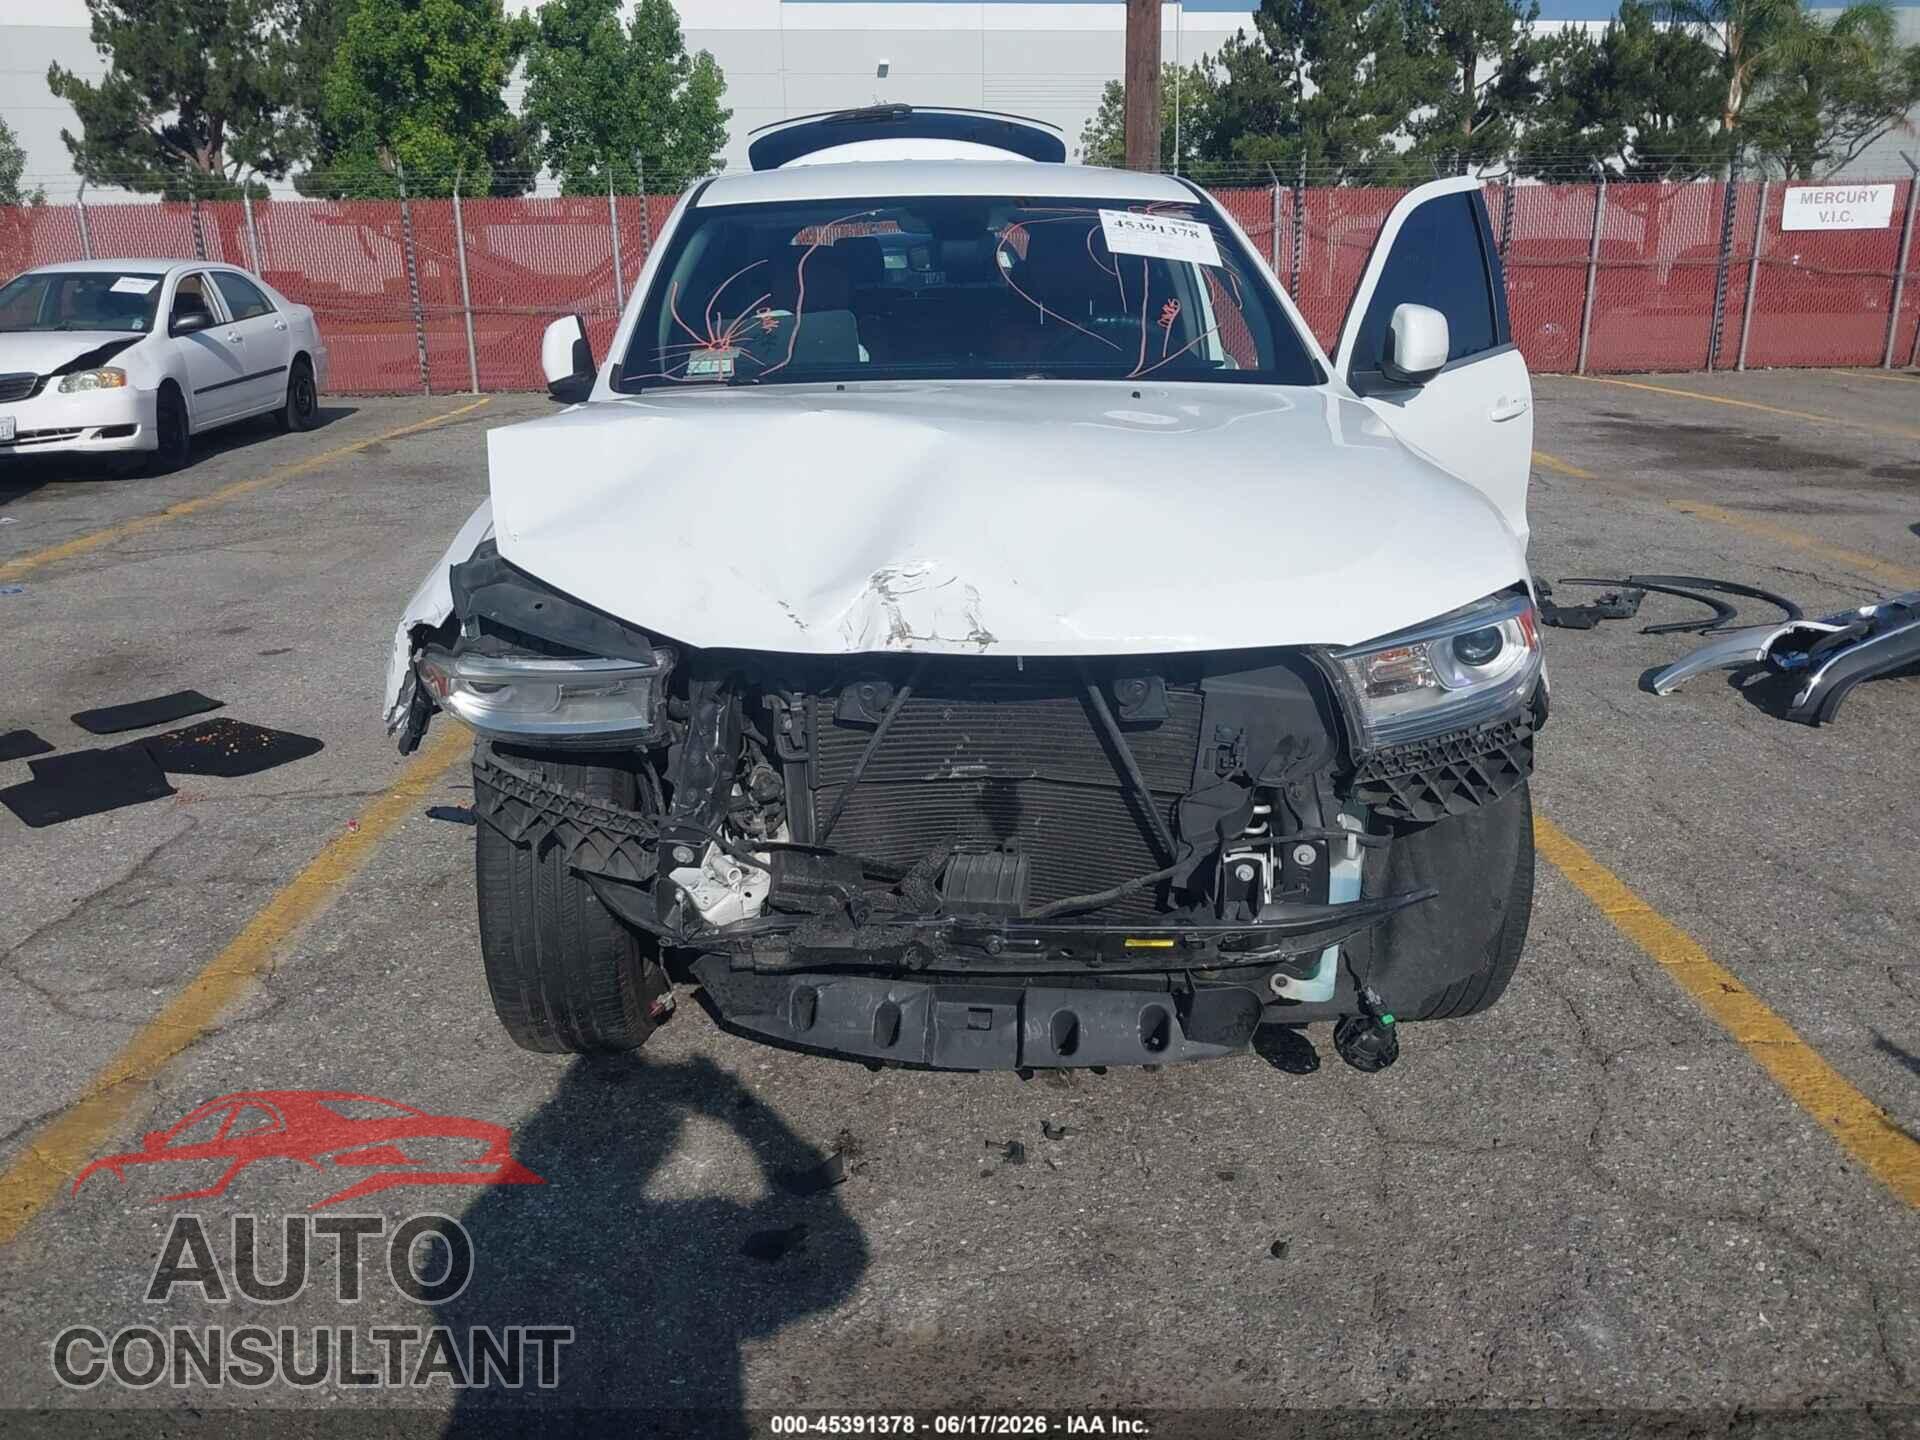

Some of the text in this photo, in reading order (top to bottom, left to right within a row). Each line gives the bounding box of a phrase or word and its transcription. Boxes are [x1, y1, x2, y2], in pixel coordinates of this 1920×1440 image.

[1800, 190, 1879, 205] MERCURY
[1819, 210, 1854, 223] V.I.C.
[1113, 219, 1200, 239] 45391378
